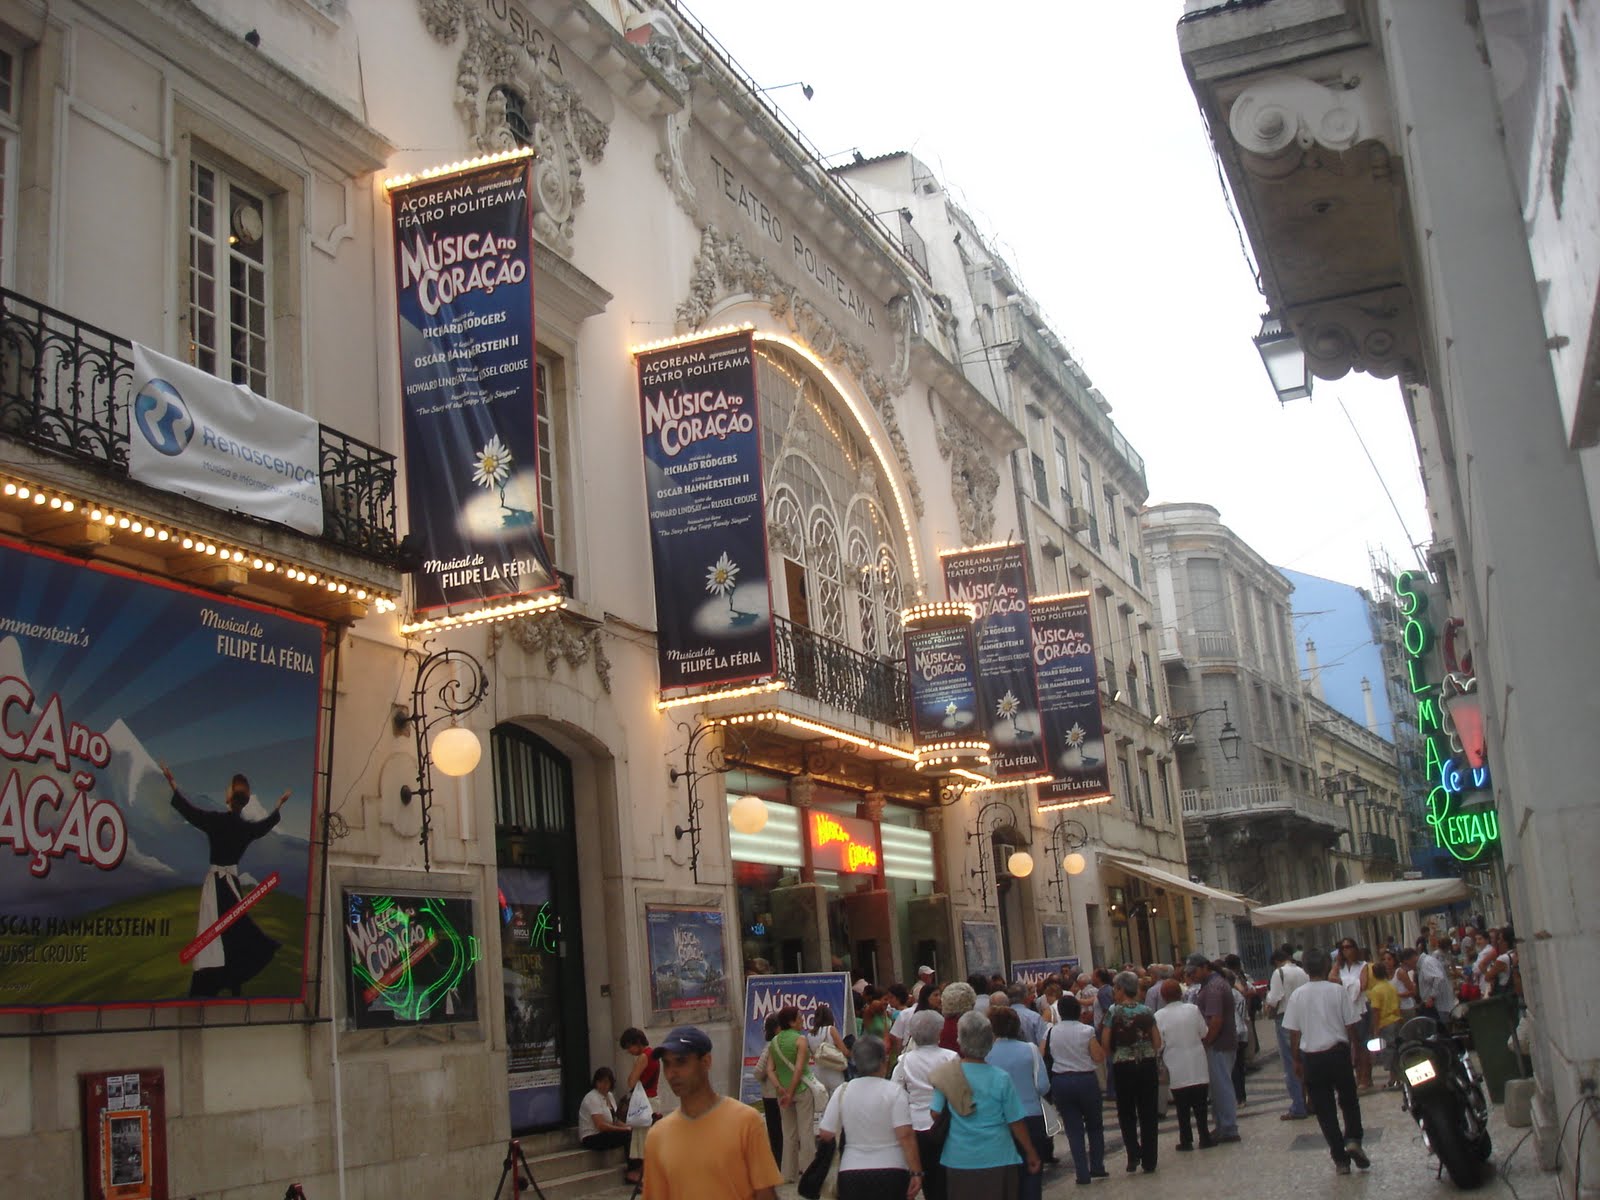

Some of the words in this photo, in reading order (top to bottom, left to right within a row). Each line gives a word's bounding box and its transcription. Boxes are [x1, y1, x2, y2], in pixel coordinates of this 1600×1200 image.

[397, 208, 445, 229] TEATRO
[450, 188, 527, 217] POLITEAMA
[400, 185, 473, 213] AÇOREANA
[710, 155, 783, 243] TEATRO
[793, 235, 878, 334] POLITEAMA
[400, 231, 498, 289] MÚSICA
[497, 238, 517, 251] no
[418, 254, 527, 316] CORAÇÃO
[422, 322, 463, 339] RICHARD
[463, 311, 507, 330] RODGERS
[414, 353, 446, 368] OSCAR
[511, 334, 519, 346] II
[644, 352, 706, 373] AÇOREANA
[406, 379, 437, 395] HOWARD
[438, 373, 467, 387] LINDSAY
[499, 359, 528, 374] CROUSE
[642, 369, 683, 386] TEATRO
[687, 356, 751, 377] POLITEAMA
[645, 389, 729, 435] MÚSICA
[728, 395, 743, 405] no
[660, 408, 753, 456] CORAÇÃO
[664, 461, 699, 476] RICHARD
[700, 454, 738, 469] RODGERS
[657, 486, 684, 499] OSCAR
[684, 475, 742, 494] HAMMERSTEIN
[742, 474, 749, 483] II
[650, 508, 677, 519] HOWARD
[677, 503, 703, 516] LINDSAY
[711, 498, 734, 509] RUSSEL
[733, 493, 758, 505] CROUSE
[424, 554, 471, 574] Musical
[471, 553, 485, 566] de
[442, 569, 481, 589] FILIPE
[483, 565, 500, 582] LA
[502, 558, 542, 578] FÉRIA
[946, 568, 975, 578] TEATRO
[948, 557, 991, 569] AÇOREANA
[200, 608, 249, 635] Musical
[250, 622, 263, 638] de
[1048, 609, 1088, 620] POLITEAMA
[934, 635, 965, 643] POLITEAMA
[217, 634, 258, 661] FILIPE
[260, 644, 276, 666] LA
[279, 646, 315, 674] FÉRIA
[666, 647, 704, 661] Musical
[704, 646, 716, 656] de
[680, 658, 713, 674] FILIPE
[714, 656, 729, 669] LA
[730, 650, 762, 667] FÉRIA
[914, 651, 954, 672] MÚSICA
[1034, 640, 1091, 666] CORAÇÃO
[922, 660, 966, 681] CORAÇÃO
[69, 722, 111, 769] no
[1005, 758, 1014, 767] LA
[1015, 754, 1037, 766] FÉRIA
[1052, 783, 1072, 792] FILIPE
[1073, 781, 1081, 790] LA
[1082, 779, 1102, 789] FÉRIA
[46, 916, 157, 937] HAMMERSTEIN
[159, 917, 171, 937] II
[42, 944, 89, 963] CROUSE
[753, 988, 818, 1020] MÚSICA
